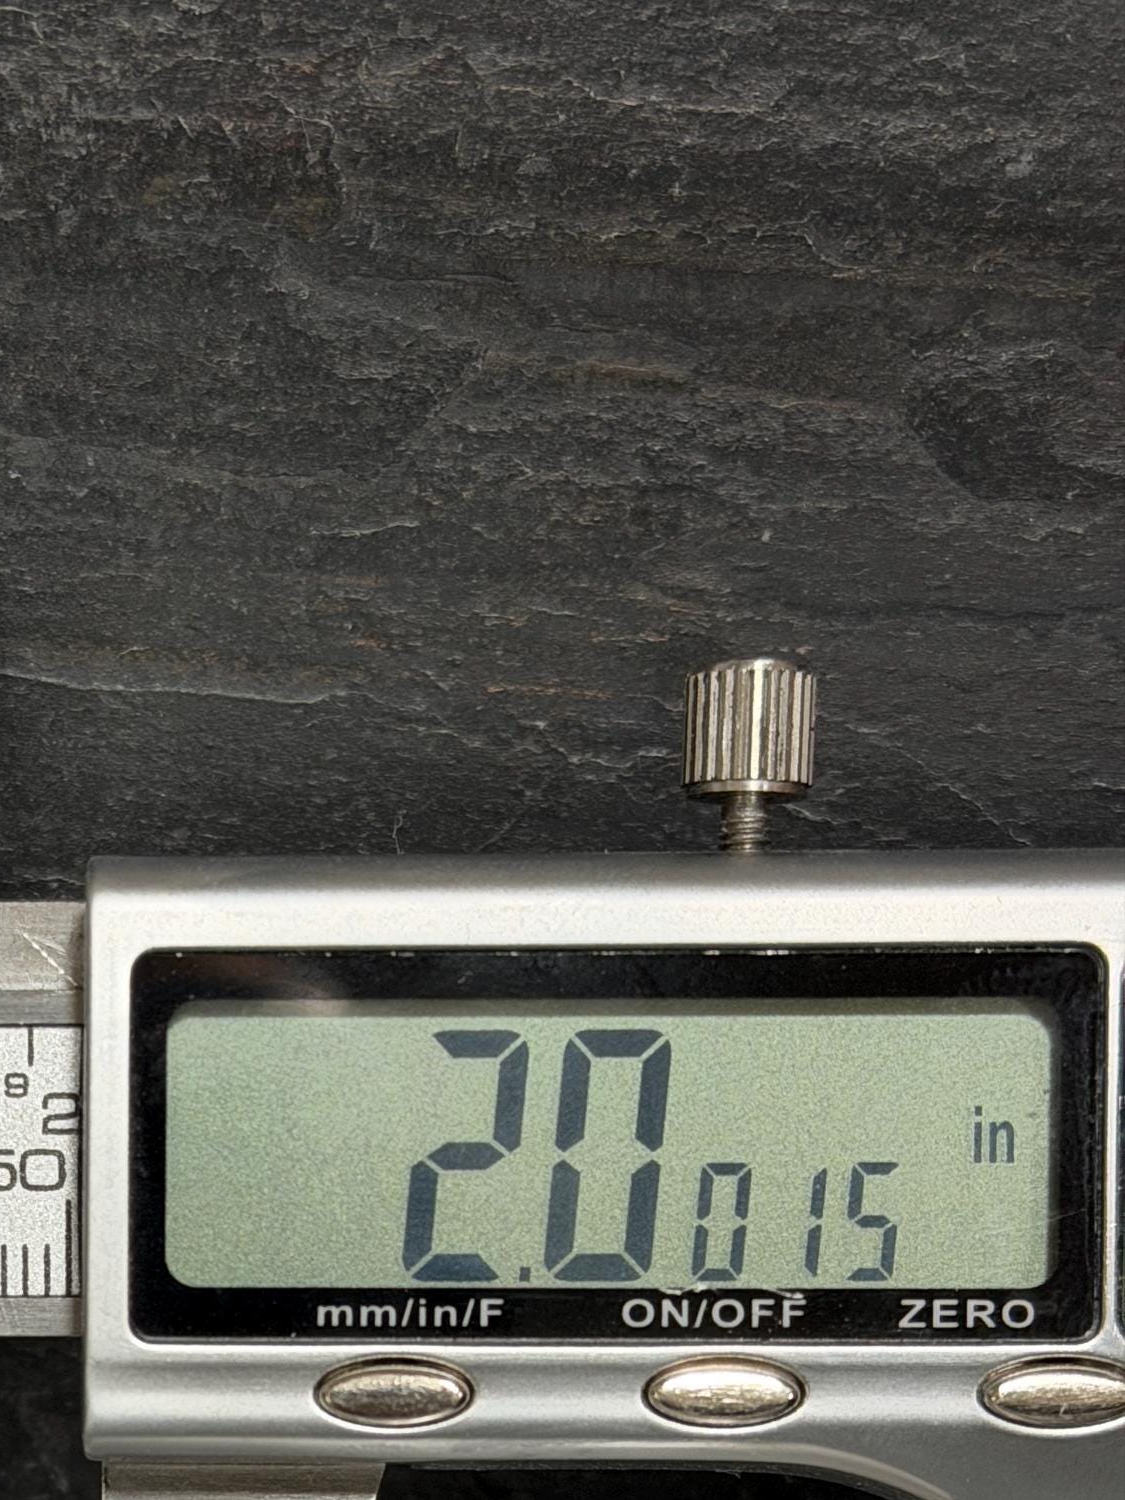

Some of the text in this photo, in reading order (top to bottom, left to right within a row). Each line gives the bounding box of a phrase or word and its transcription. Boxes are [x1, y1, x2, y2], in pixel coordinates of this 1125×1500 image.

[4, 1073, 29, 1098] 9
[41, 1093, 81, 1135] 2
[972, 1106, 1015, 1163] in
[316, 1298, 1036, 1330] mm/in/F ON/OFF ZERO
